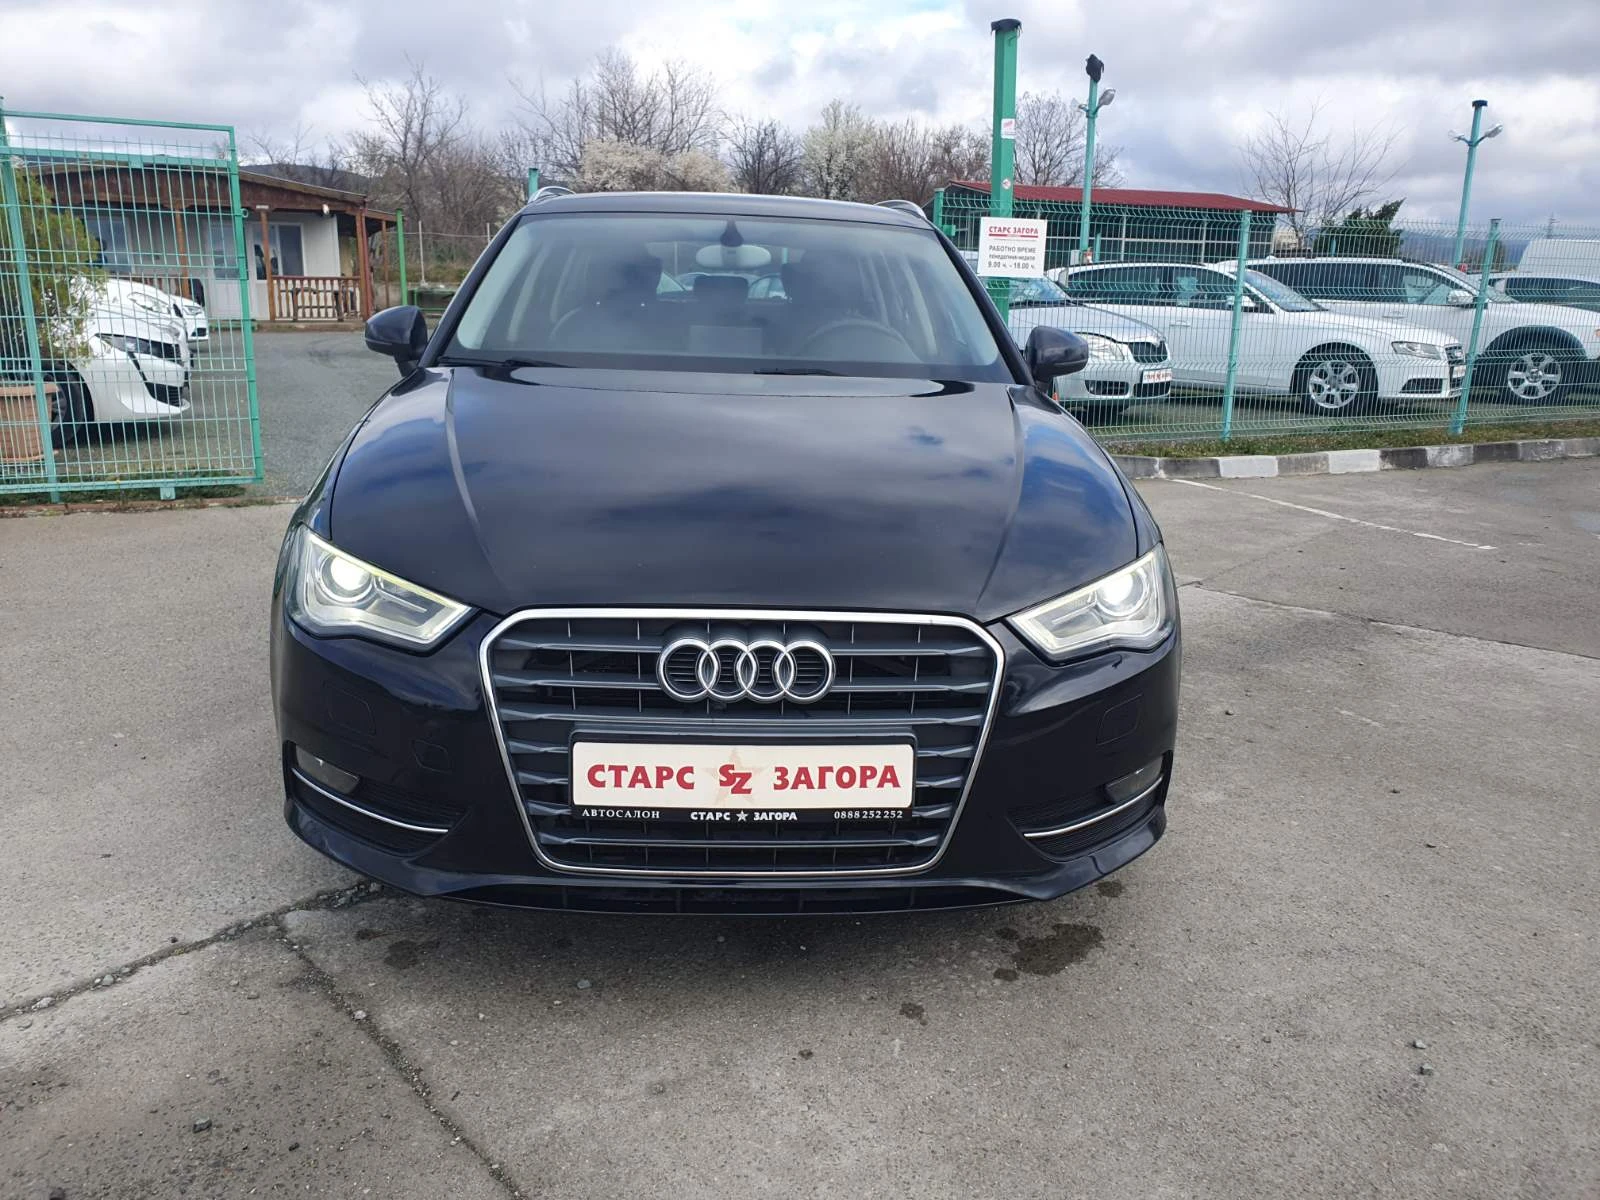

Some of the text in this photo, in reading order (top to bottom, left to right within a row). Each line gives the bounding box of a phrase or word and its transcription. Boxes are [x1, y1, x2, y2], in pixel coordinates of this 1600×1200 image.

[587, 764, 695, 790] СТАРС
[773, 765, 901, 791] ЗАГОРА
[582, 808, 660, 819] АВТОСАЛОН
[690, 811, 798, 821] СТАРС ЗАГОРА
[834, 810, 903, 819] 0888 252 252
